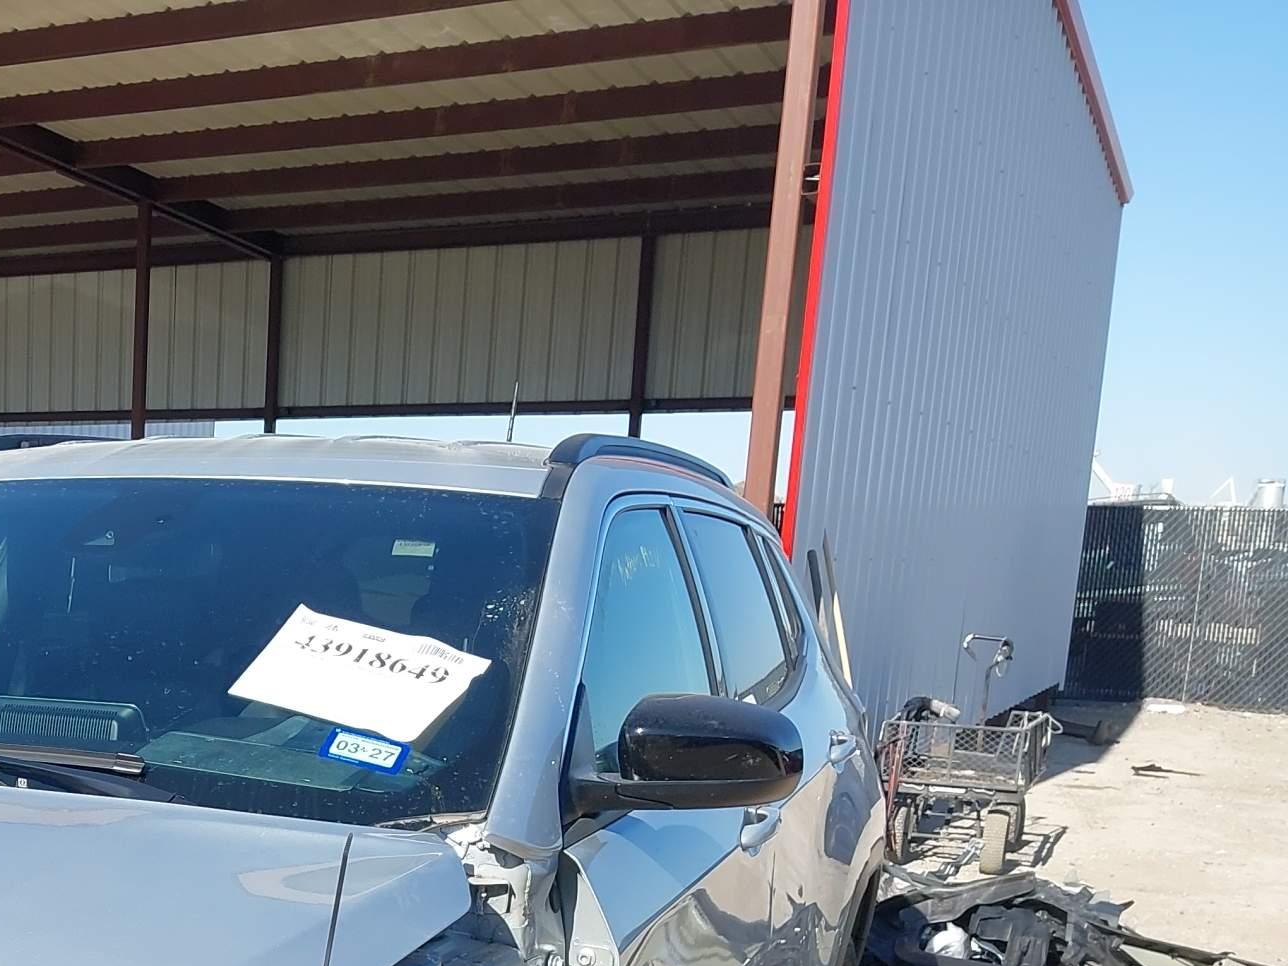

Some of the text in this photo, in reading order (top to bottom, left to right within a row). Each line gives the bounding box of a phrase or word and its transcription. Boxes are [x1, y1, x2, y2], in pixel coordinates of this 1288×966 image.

[294, 634, 450, 684] 43918649
[336, 739, 360, 754] 03
[368, 747, 396, 762] 27
